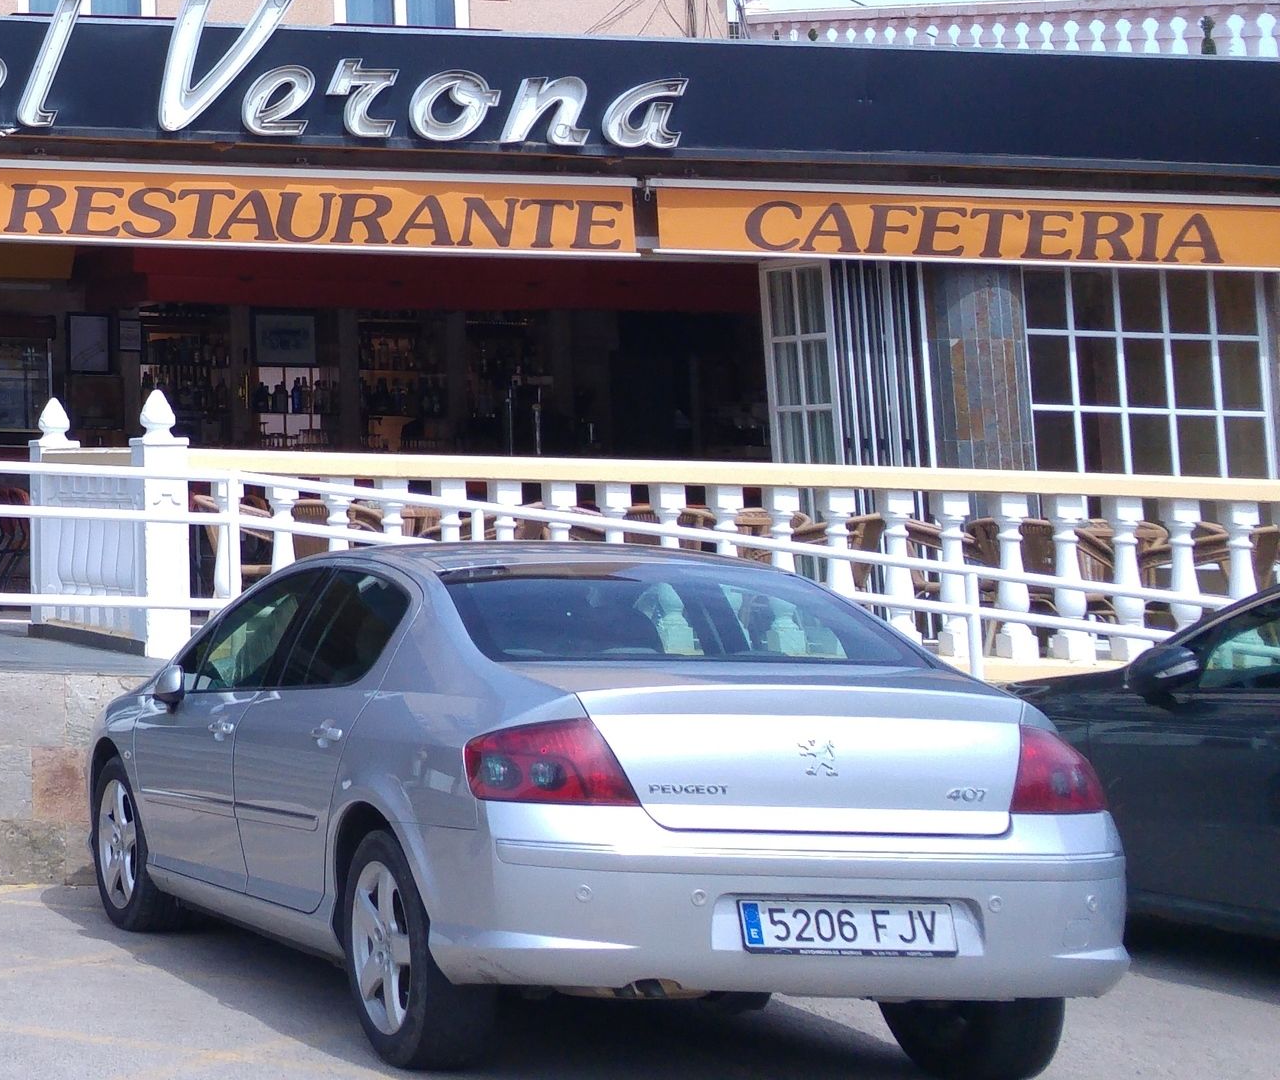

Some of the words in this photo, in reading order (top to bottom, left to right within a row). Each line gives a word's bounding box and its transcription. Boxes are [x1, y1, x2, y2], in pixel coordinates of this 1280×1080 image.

[2, 183, 623, 250] RESTAURANTE
[744, 200, 1226, 264] CAFETERIA
[648, 783, 729, 796] PEUGEOT
[946, 788, 987, 802] 407
[750, 928, 760, 939] E
[768, 907, 858, 943] 5206
[870, 909, 937, 945] FJV
